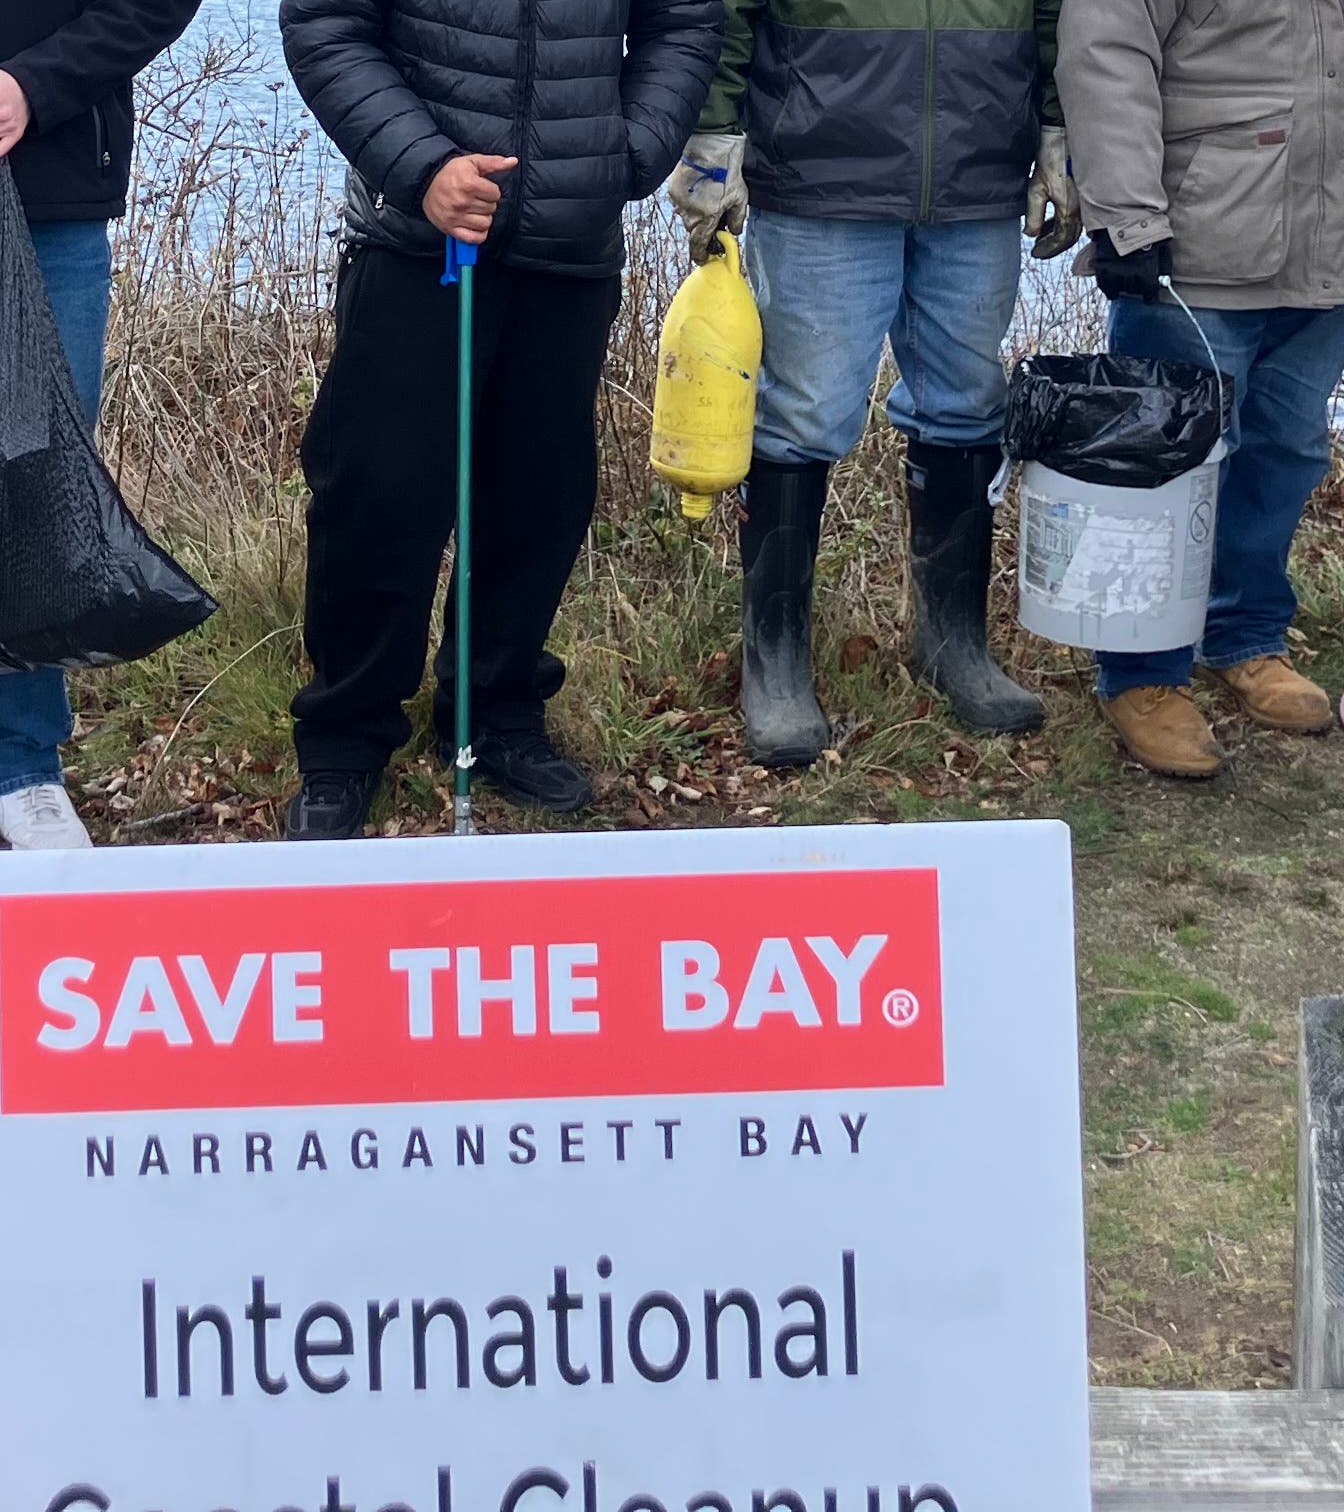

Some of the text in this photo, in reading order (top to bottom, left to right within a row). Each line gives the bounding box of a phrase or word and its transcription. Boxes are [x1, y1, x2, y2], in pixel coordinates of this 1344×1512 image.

[36, 951, 324, 1050] SAVE
[389, 942, 600, 1039] THE
[85, 1111, 869, 1178] NARRAGANSETT BAY
[141, 1248, 858, 1400] International
